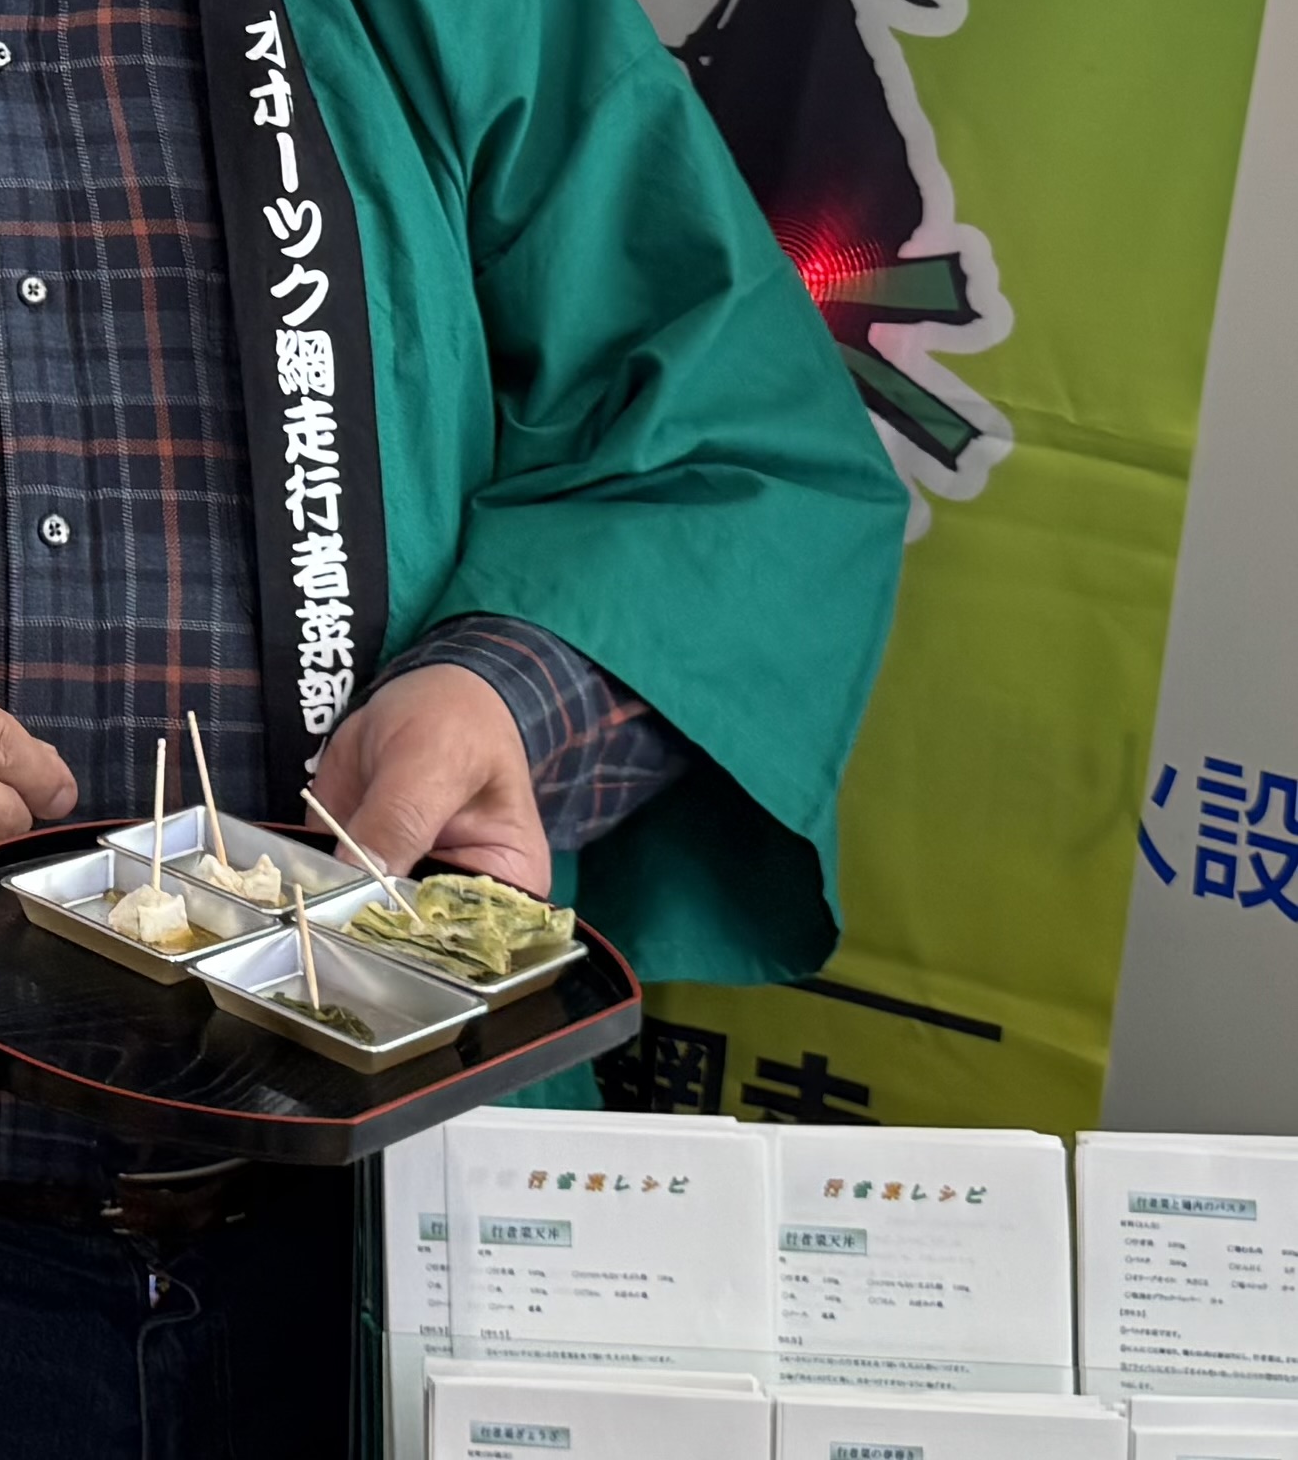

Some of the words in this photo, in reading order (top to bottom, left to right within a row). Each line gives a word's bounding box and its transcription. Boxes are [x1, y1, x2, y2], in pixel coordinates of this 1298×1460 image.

[243, 9, 356, 786] オホーツク網走行者菜部
